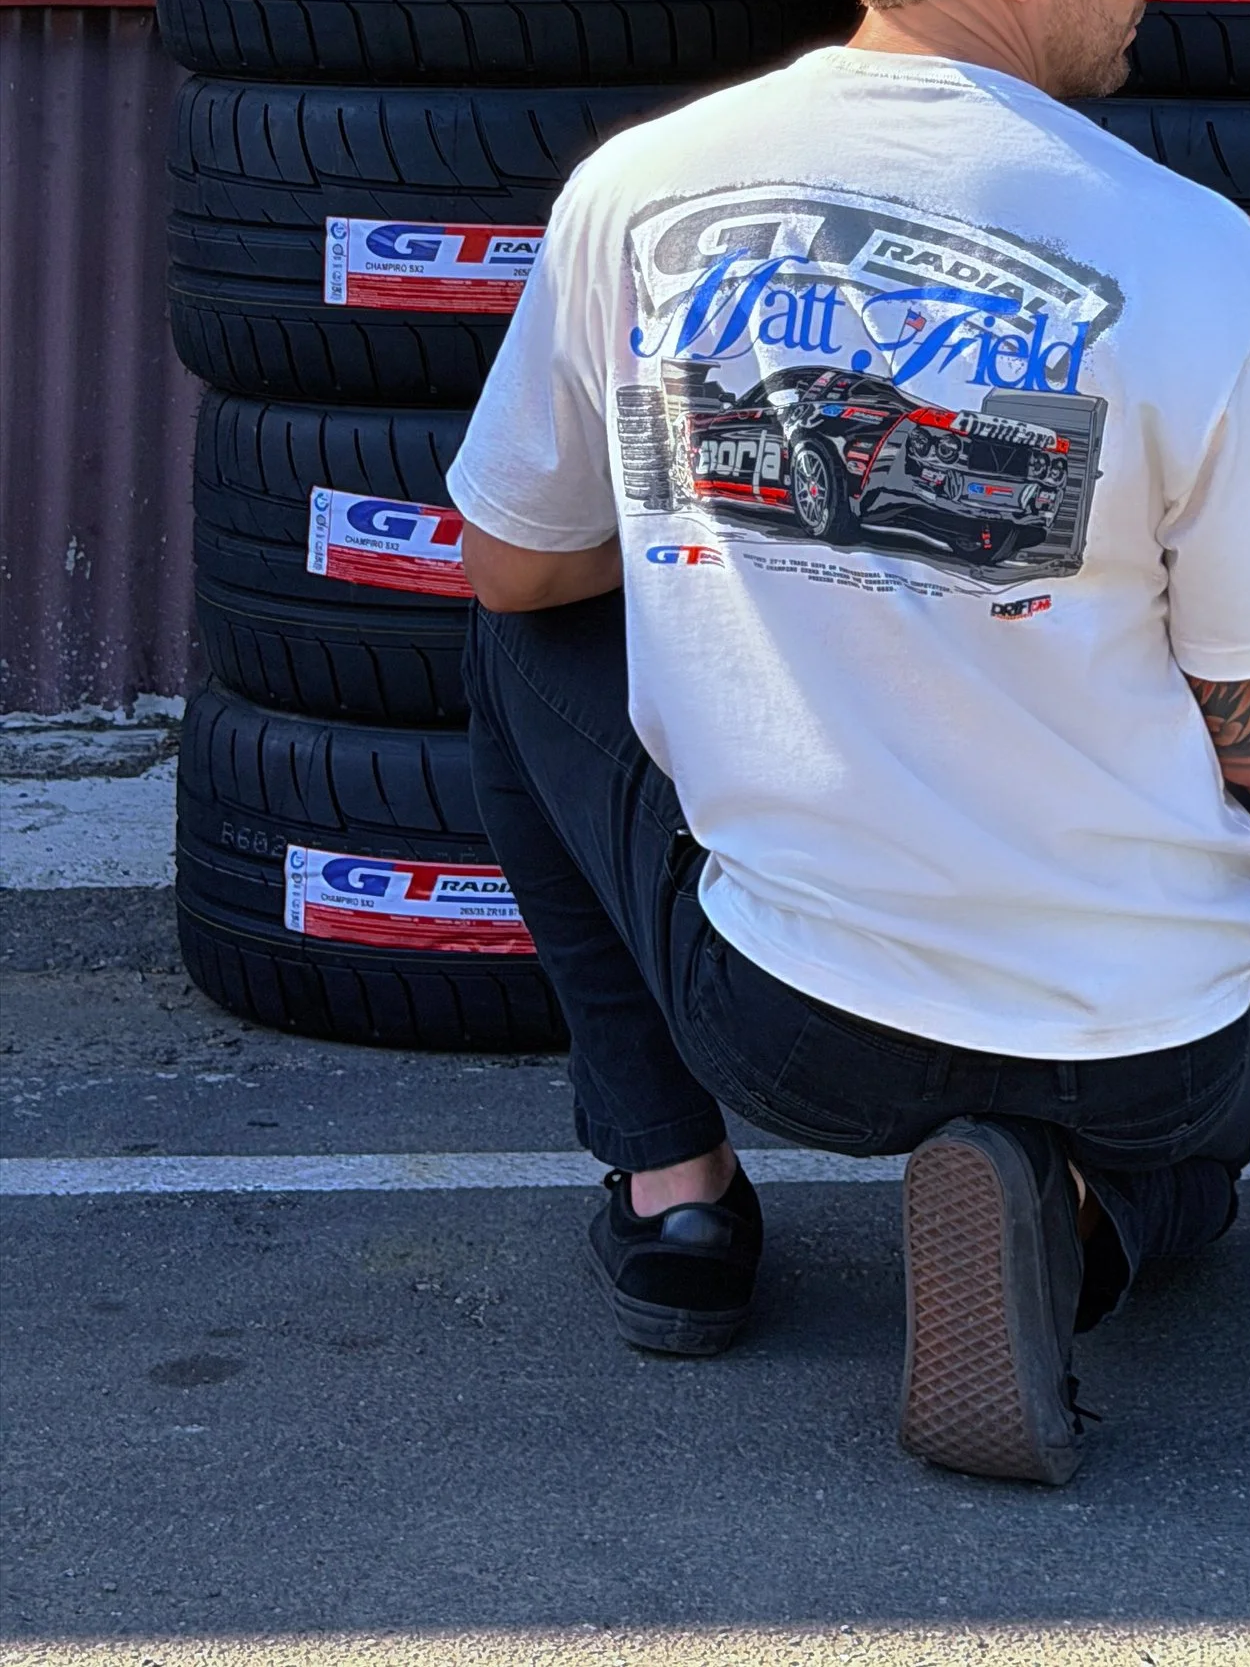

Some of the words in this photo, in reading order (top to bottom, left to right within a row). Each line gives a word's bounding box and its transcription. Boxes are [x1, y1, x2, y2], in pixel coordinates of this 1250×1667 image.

[365, 261, 408, 273] CHAMPIRO
[410, 263, 425, 273] SX2
[873, 239, 1048, 313] RADIAL
[631, 247, 848, 359] Matt
[851, 287, 1091, 395] Field
[345, 534, 383, 549] CHAMPIRO
[346, 499, 464, 547] GT
